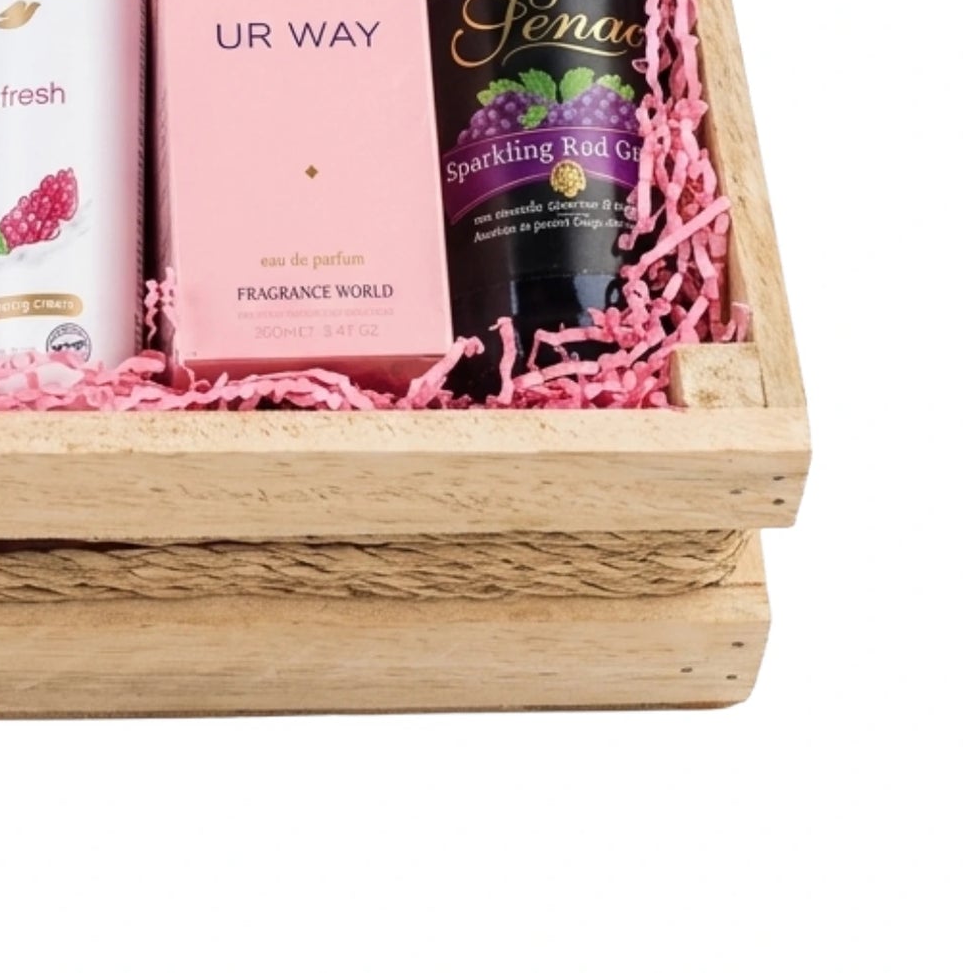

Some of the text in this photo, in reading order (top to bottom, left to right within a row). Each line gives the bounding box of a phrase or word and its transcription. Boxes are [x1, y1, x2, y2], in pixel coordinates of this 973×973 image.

[216, 21, 381, 49] UR WAY
[1, 81, 67, 109] fresh
[260, 251, 365, 270] eau de parfum
[237, 283, 394, 301] FRAGRANCE WORLD
